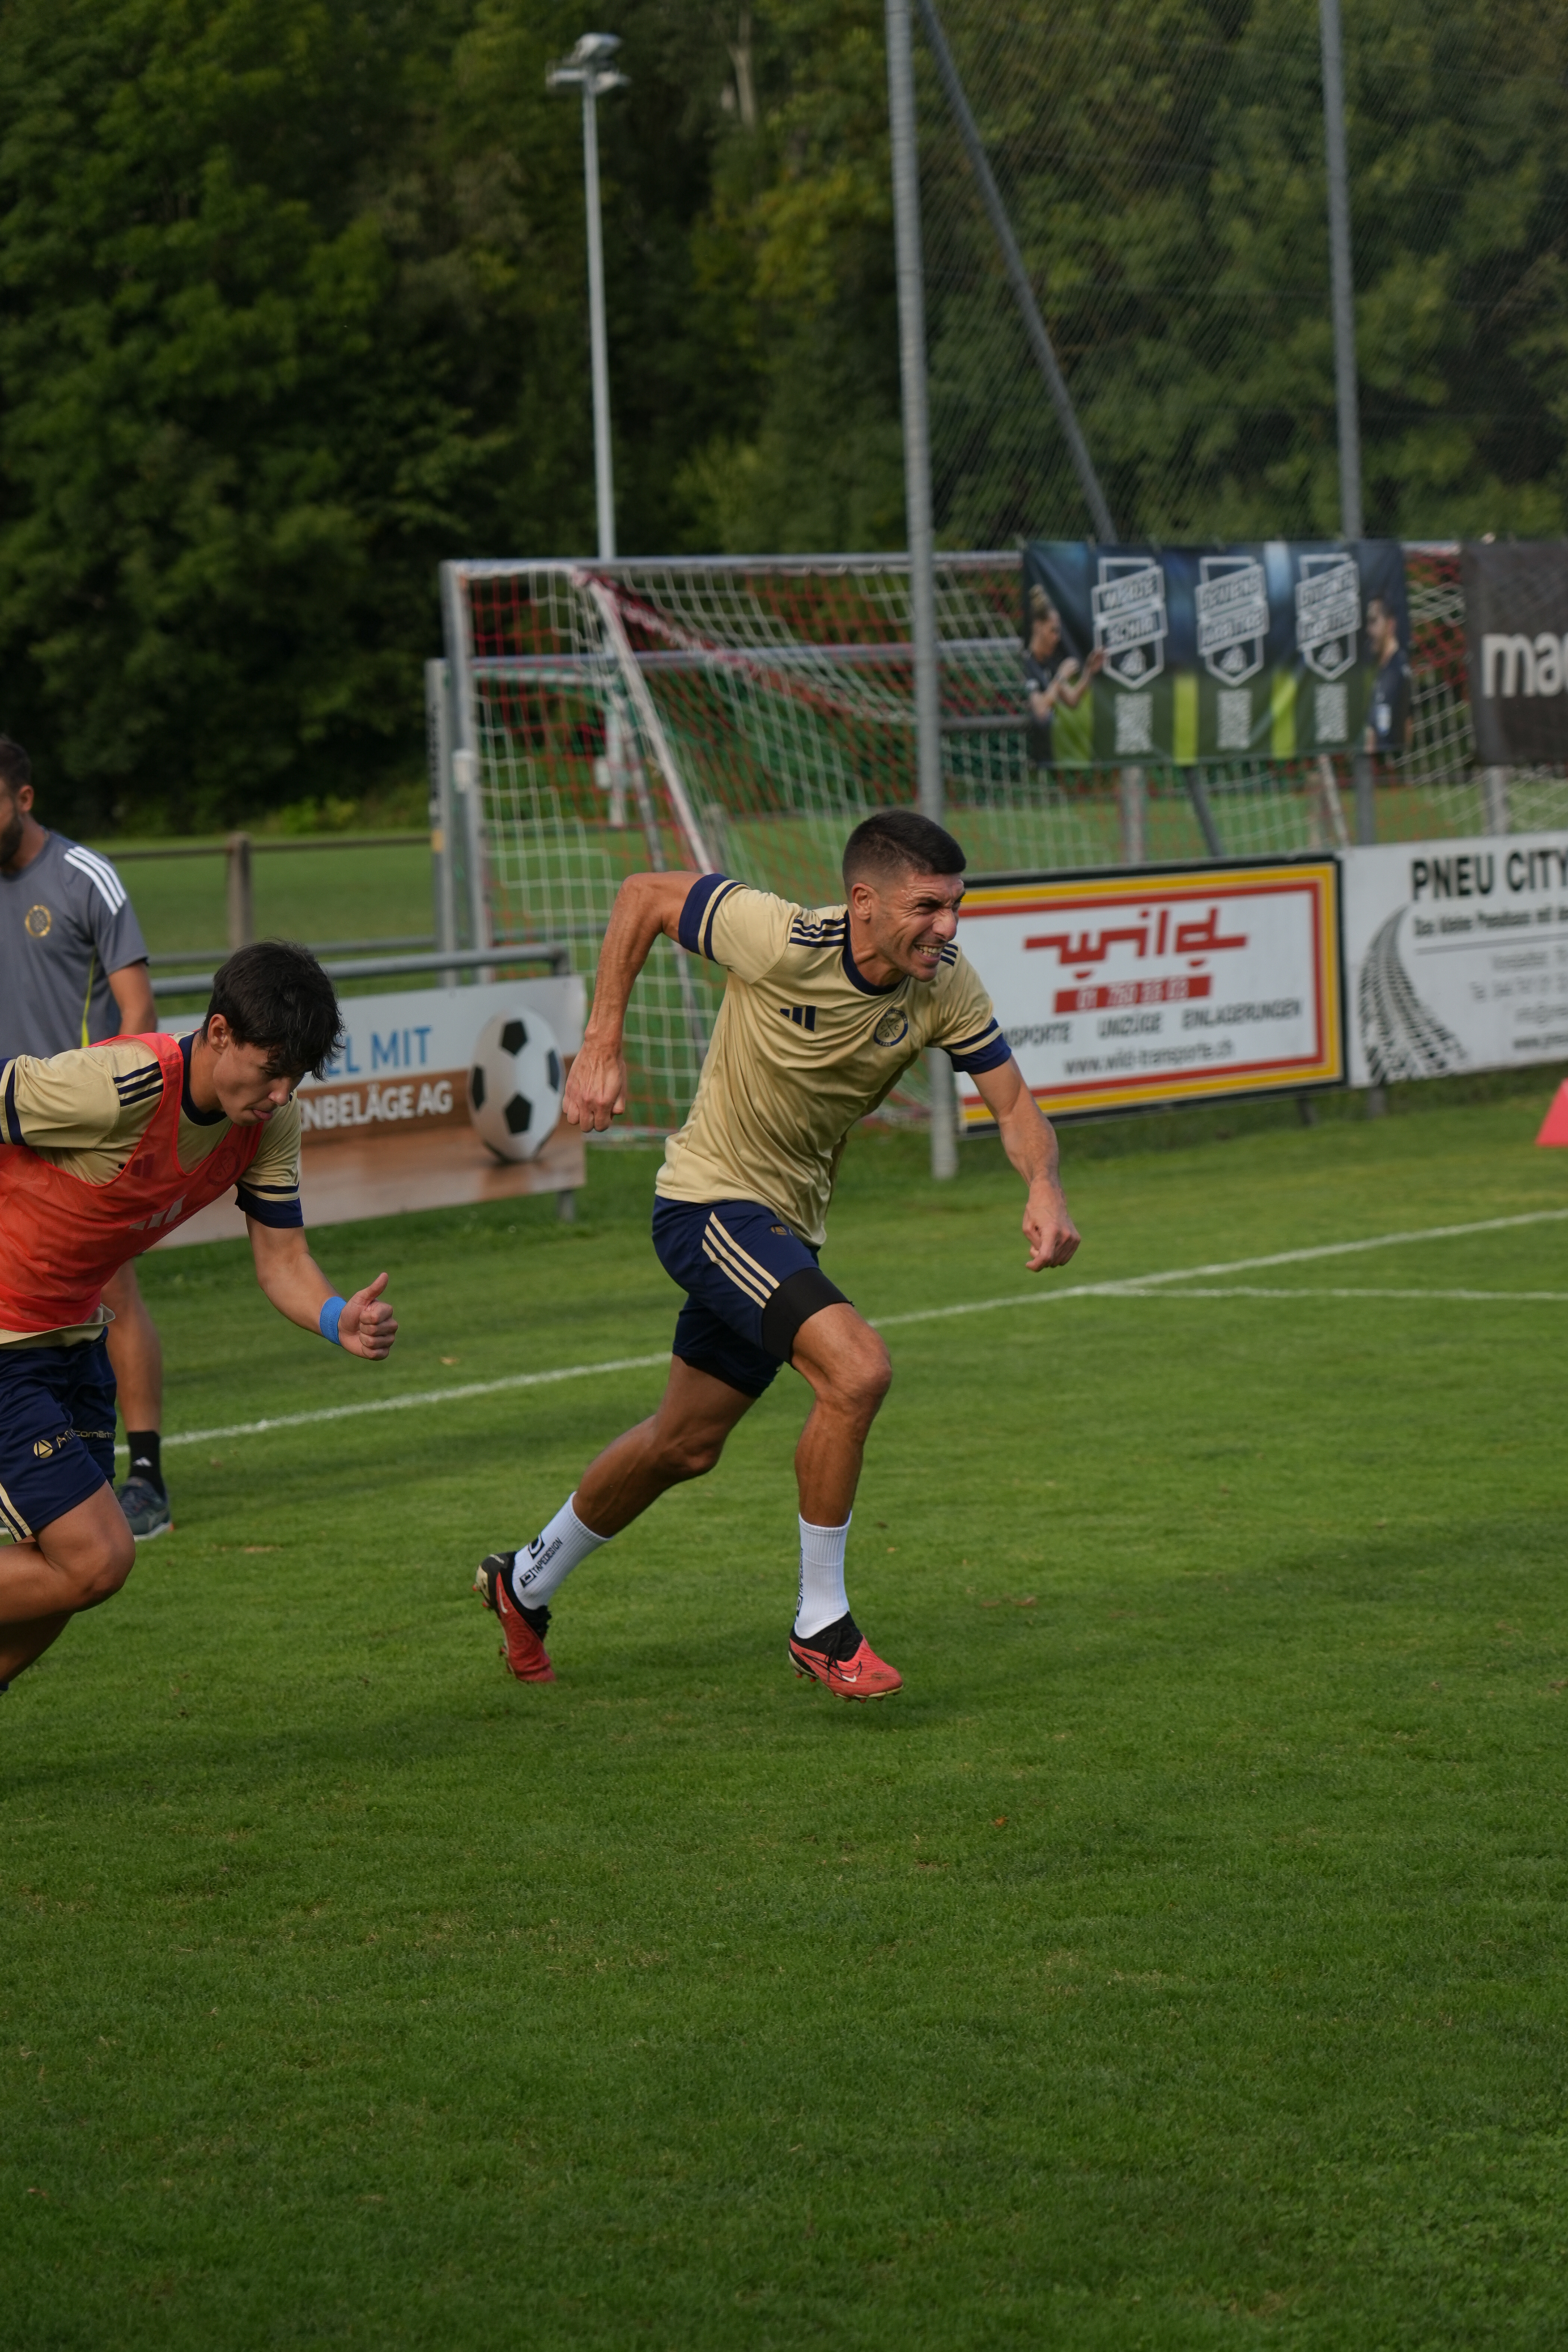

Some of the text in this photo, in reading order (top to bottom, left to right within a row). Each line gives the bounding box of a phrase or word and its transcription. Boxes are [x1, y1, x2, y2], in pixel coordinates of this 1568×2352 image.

[1480, 630, 1568, 699] ma
[1412, 845, 1568, 901] PNEU CITY
[371, 1026, 432, 1072] MIT
[416, 1080, 453, 1117] AG
[531, 1537, 564, 1574] TAPEDESIGN
